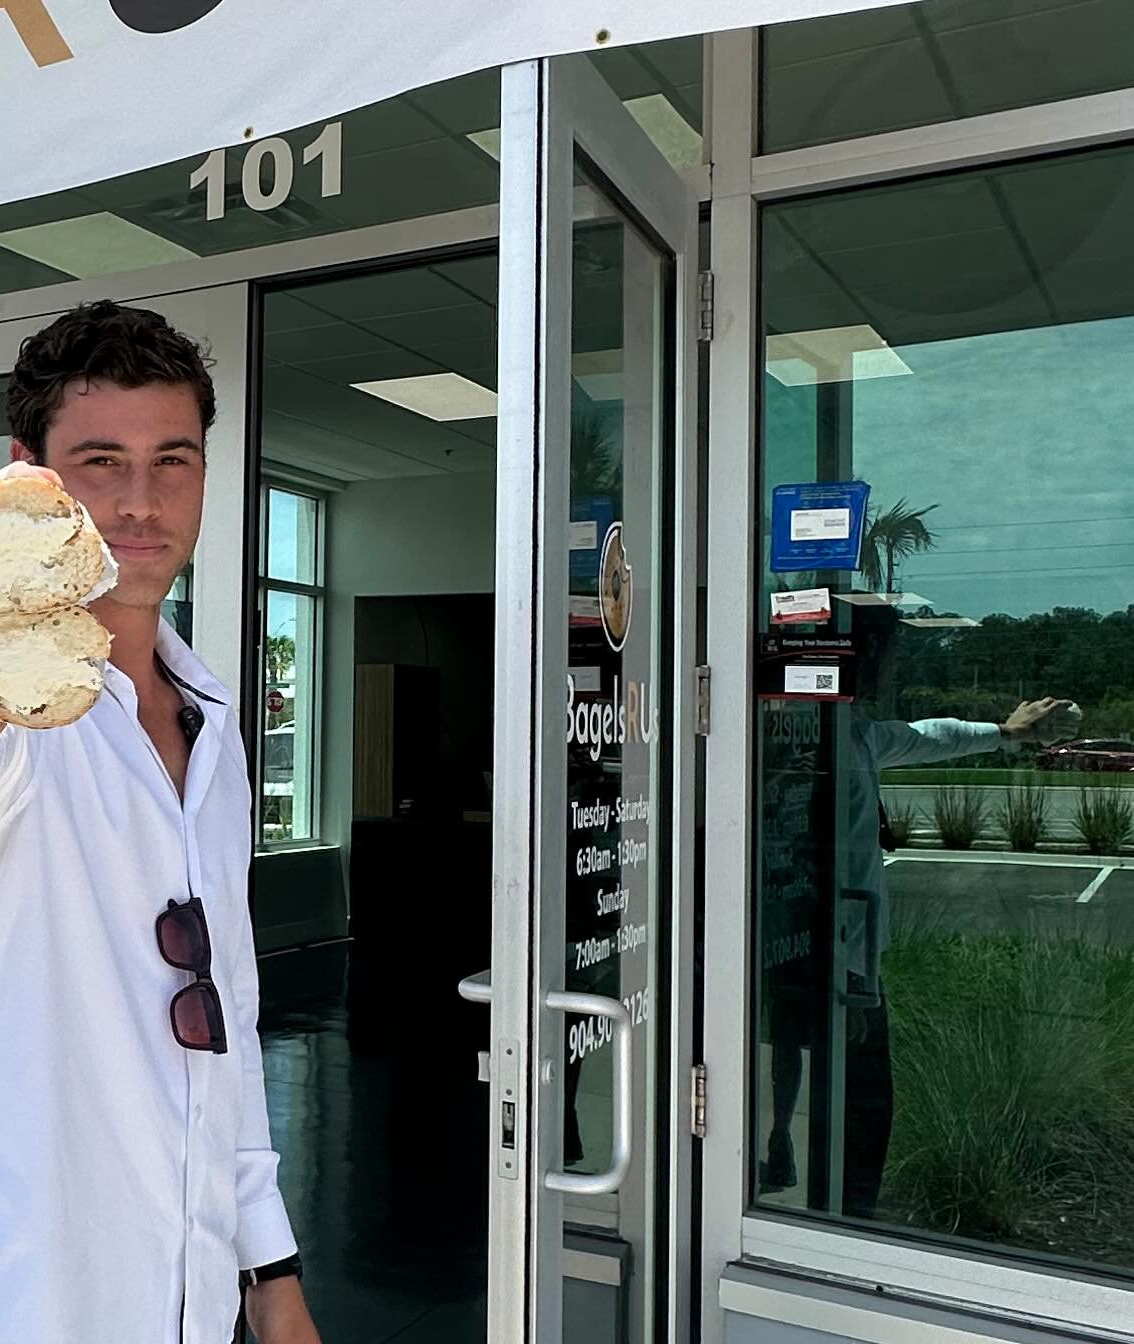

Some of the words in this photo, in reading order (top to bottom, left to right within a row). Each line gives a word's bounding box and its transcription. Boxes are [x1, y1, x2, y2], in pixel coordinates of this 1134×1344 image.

[190, 121, 343, 222] 101
[571, 797, 610, 832] Tuesday
[615, 793, 650, 825] Saturday
[576, 845, 611, 876] 6:30am
[617, 838, 647, 870] 1:30pm
[597, 883, 629, 916] Sunday
[575, 937, 610, 970] 7:00am
[616, 924, 646, 953] 1:30pm
